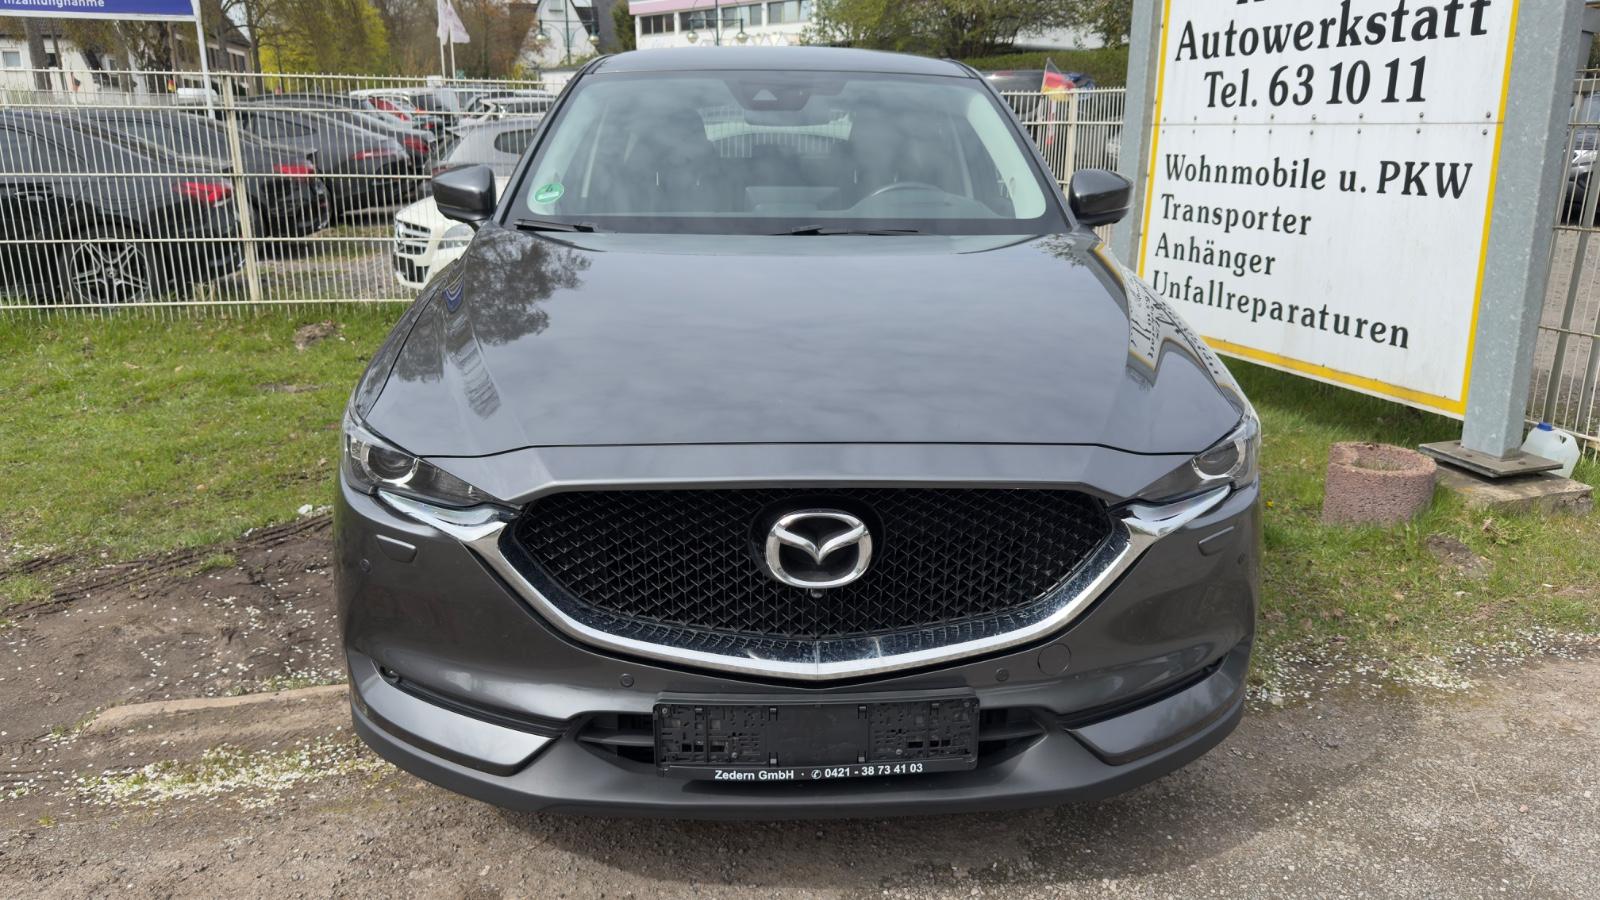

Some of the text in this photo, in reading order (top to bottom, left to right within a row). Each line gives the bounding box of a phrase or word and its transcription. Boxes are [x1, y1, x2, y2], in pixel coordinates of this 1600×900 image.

[1175, 0, 1491, 61] Autowerkstatt
[1204, 56, 1427, 108] Tel. 63 10 11
[1165, 153, 1474, 200] Wohnmobile u. PKW
[1161, 193, 1312, 236] Transporter
[1154, 232, 1277, 278] Anhänger
[1152, 270, 1410, 350] Unfallreparaturen
[714, 770, 755, 780] Zedern
[758, 770, 795, 780] GmbH
[824, 767, 851, 778] 0421
[861, 766, 875, 776] 38
[877, 765, 892, 775] 73
[893, 764, 907, 774] 41
[909, 763, 924, 773] 03
